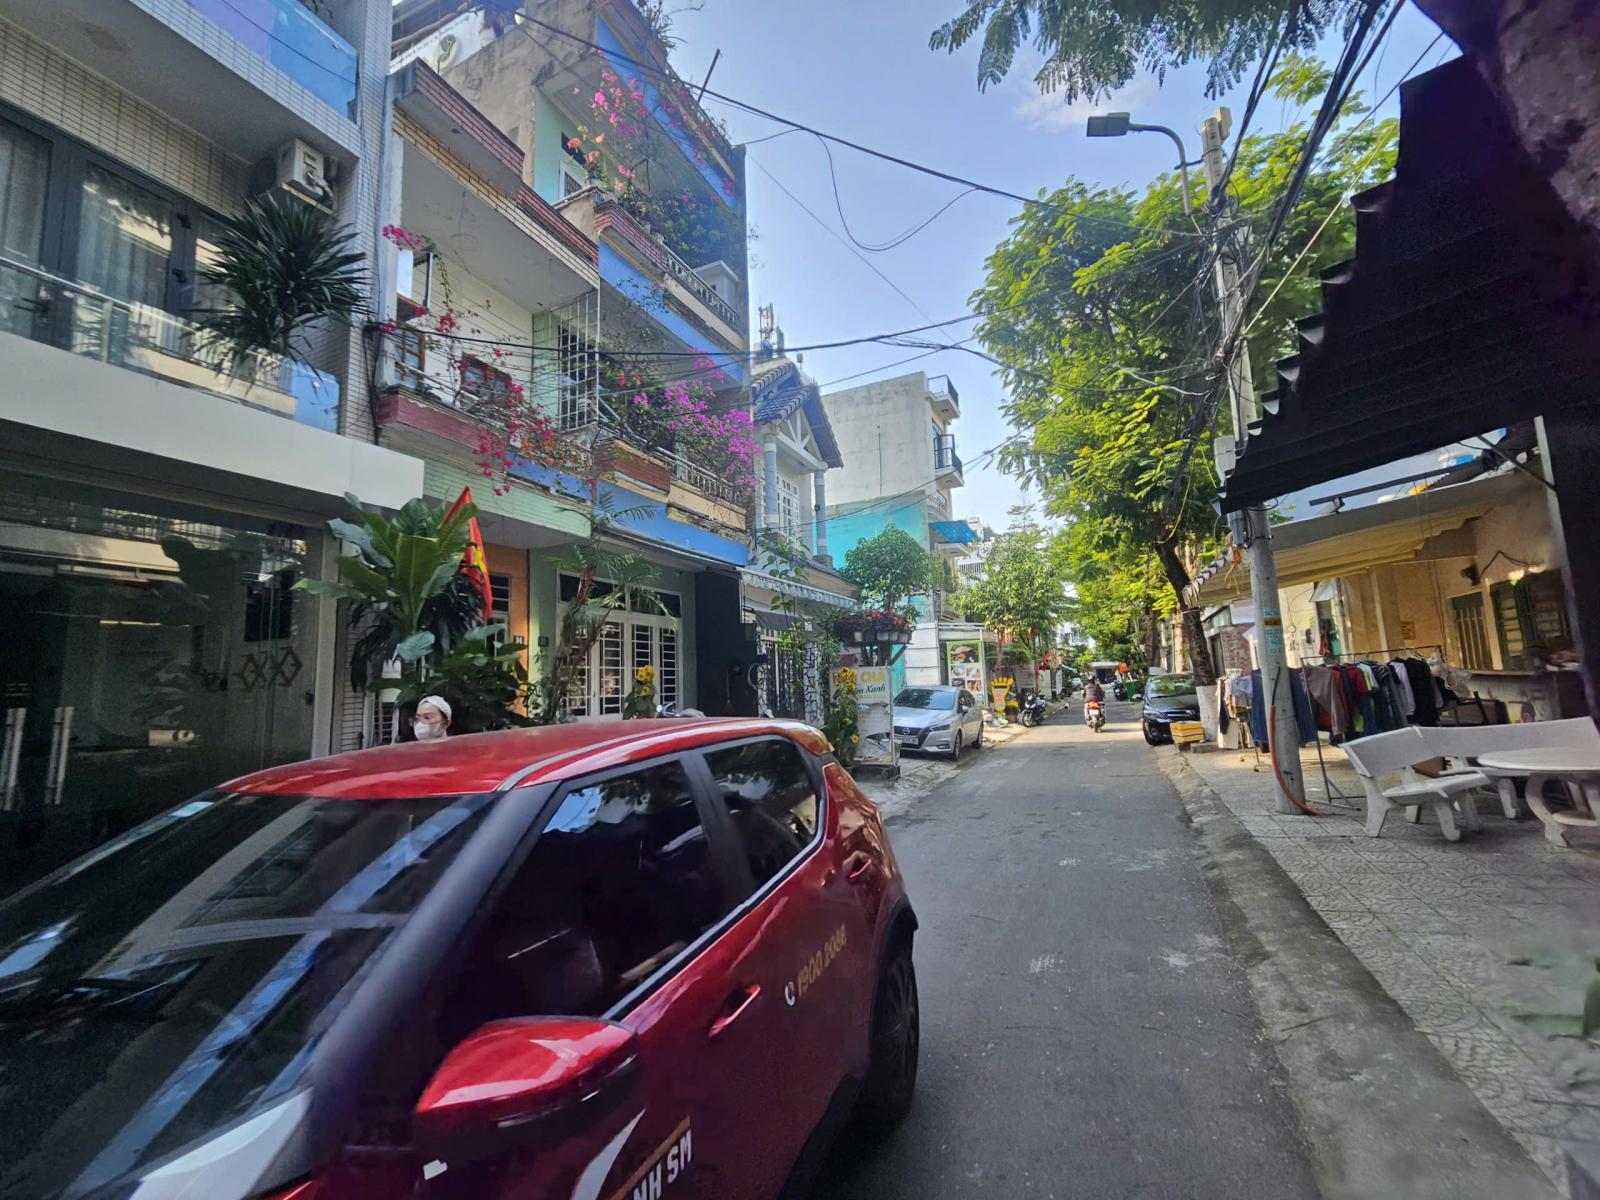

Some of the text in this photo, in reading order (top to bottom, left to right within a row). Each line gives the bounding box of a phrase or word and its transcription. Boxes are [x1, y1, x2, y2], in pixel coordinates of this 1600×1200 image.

[865, 683, 886, 693] Xanh
[797, 949, 823, 998] 1900
[666, 1129, 692, 1184] SM
